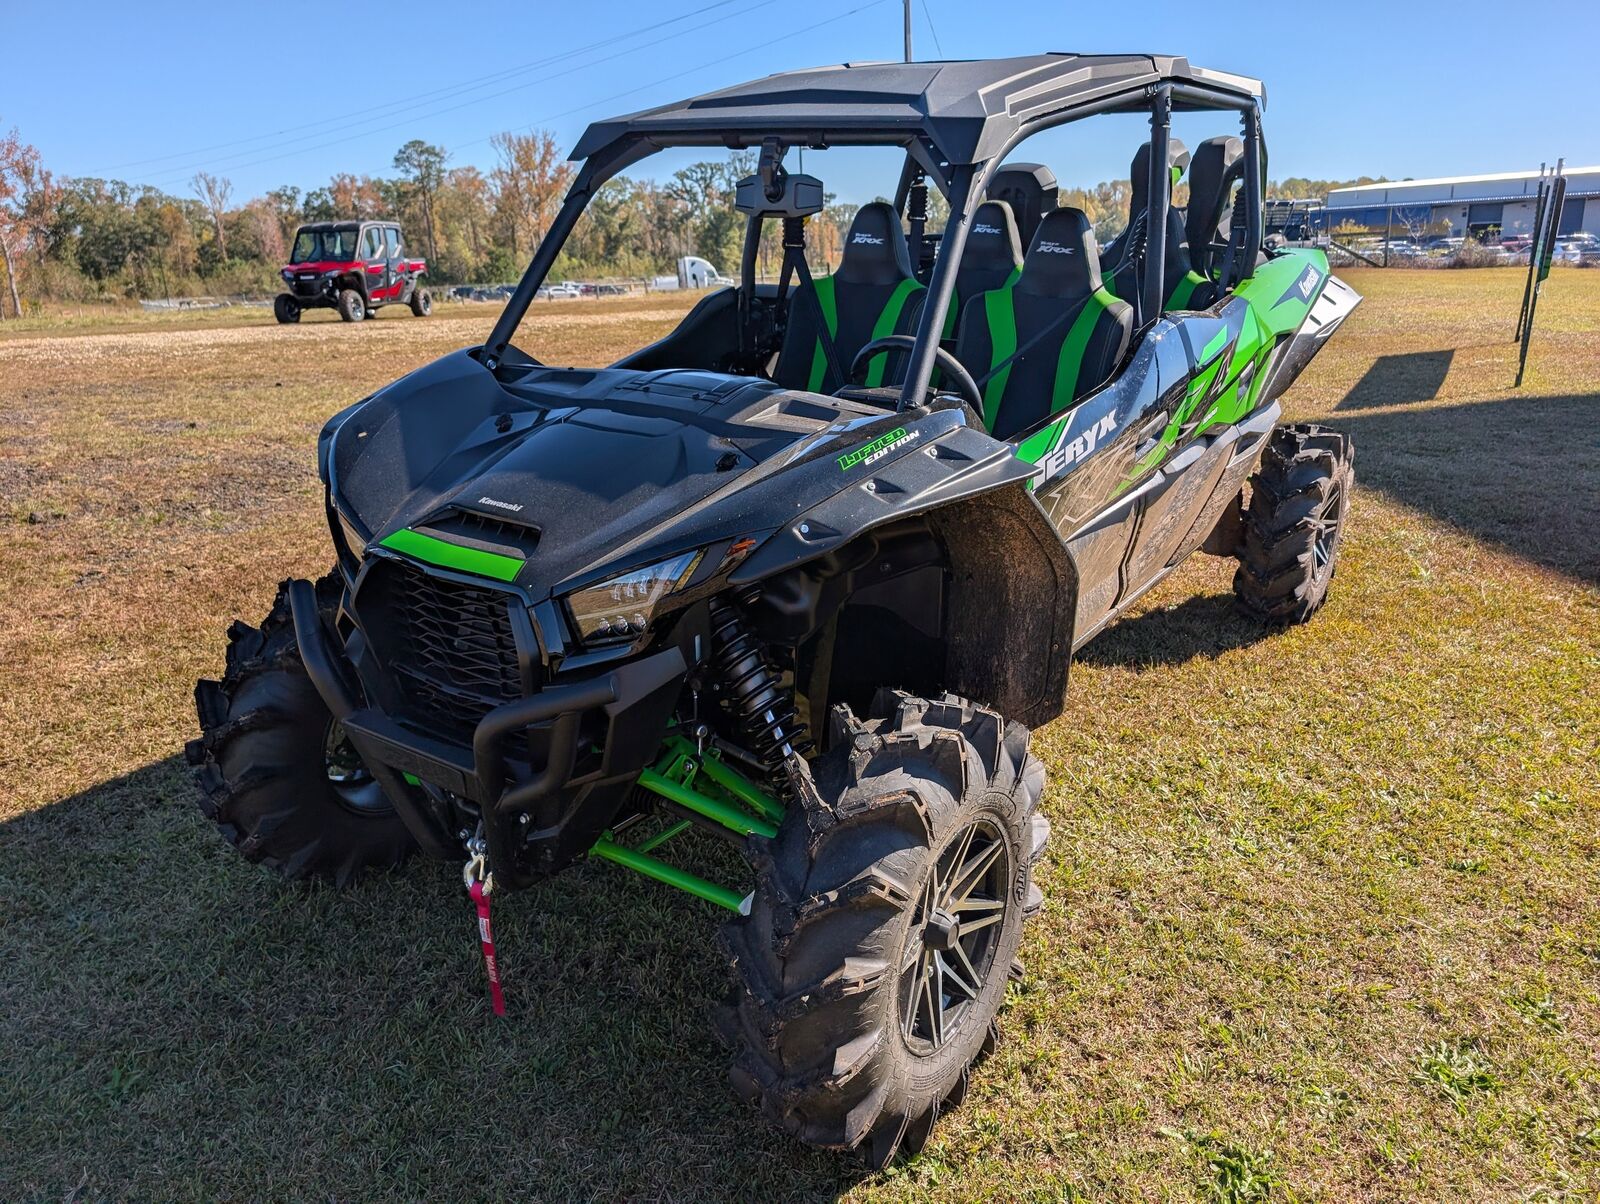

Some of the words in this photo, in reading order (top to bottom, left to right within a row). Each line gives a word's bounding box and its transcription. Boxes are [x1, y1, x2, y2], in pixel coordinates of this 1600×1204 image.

[837, 427, 907, 471] LIFTED
[864, 429, 920, 466] EDITION
[478, 496, 523, 511] Kawasaki
